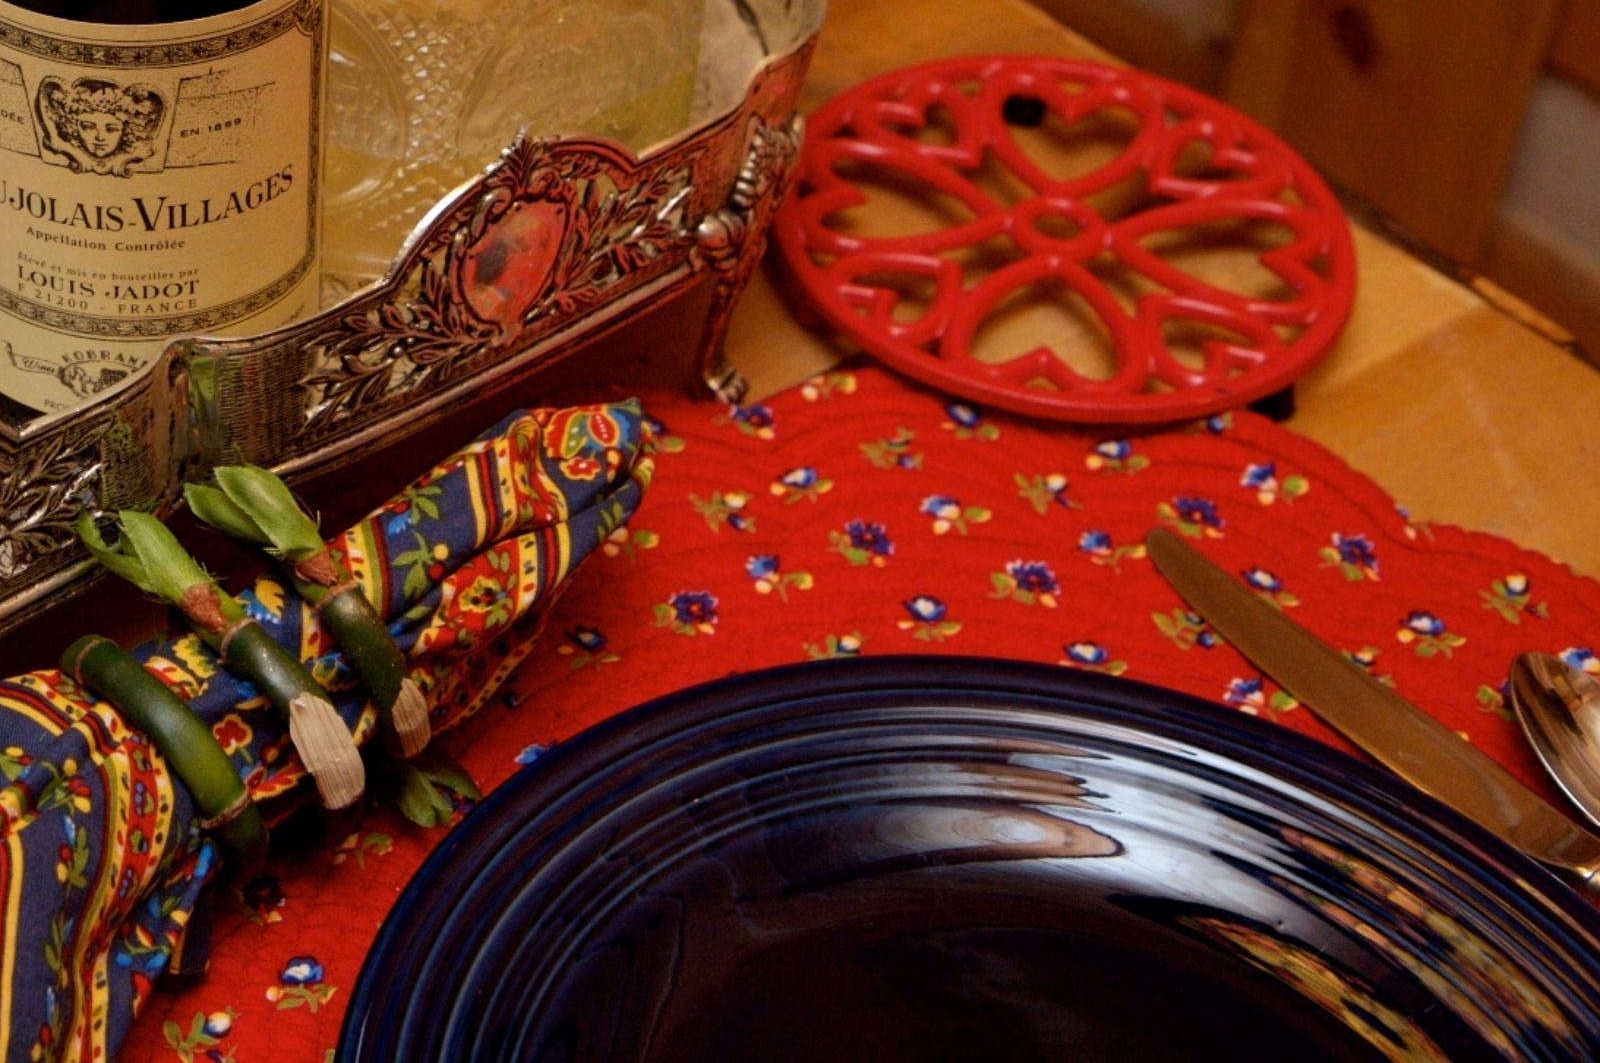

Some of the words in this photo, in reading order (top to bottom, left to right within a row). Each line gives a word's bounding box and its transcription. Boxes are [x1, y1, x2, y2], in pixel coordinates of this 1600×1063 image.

[180, 128, 200, 138] EN
[26, 225, 107, 251] Appellation
[114, 239, 186, 253] Contrôlée
[17, 264, 96, 298] LOUIS
[104, 279, 200, 300] JADOT
[50, 263, 62, 273] et
[66, 267, 87, 279] mis
[91, 271, 107, 281] en
[111, 271, 175, 282] bouteilles
[179, 267, 199, 280] par
[34, 288, 89, 311] 21200
[117, 298, 198, 314] FRANCE
